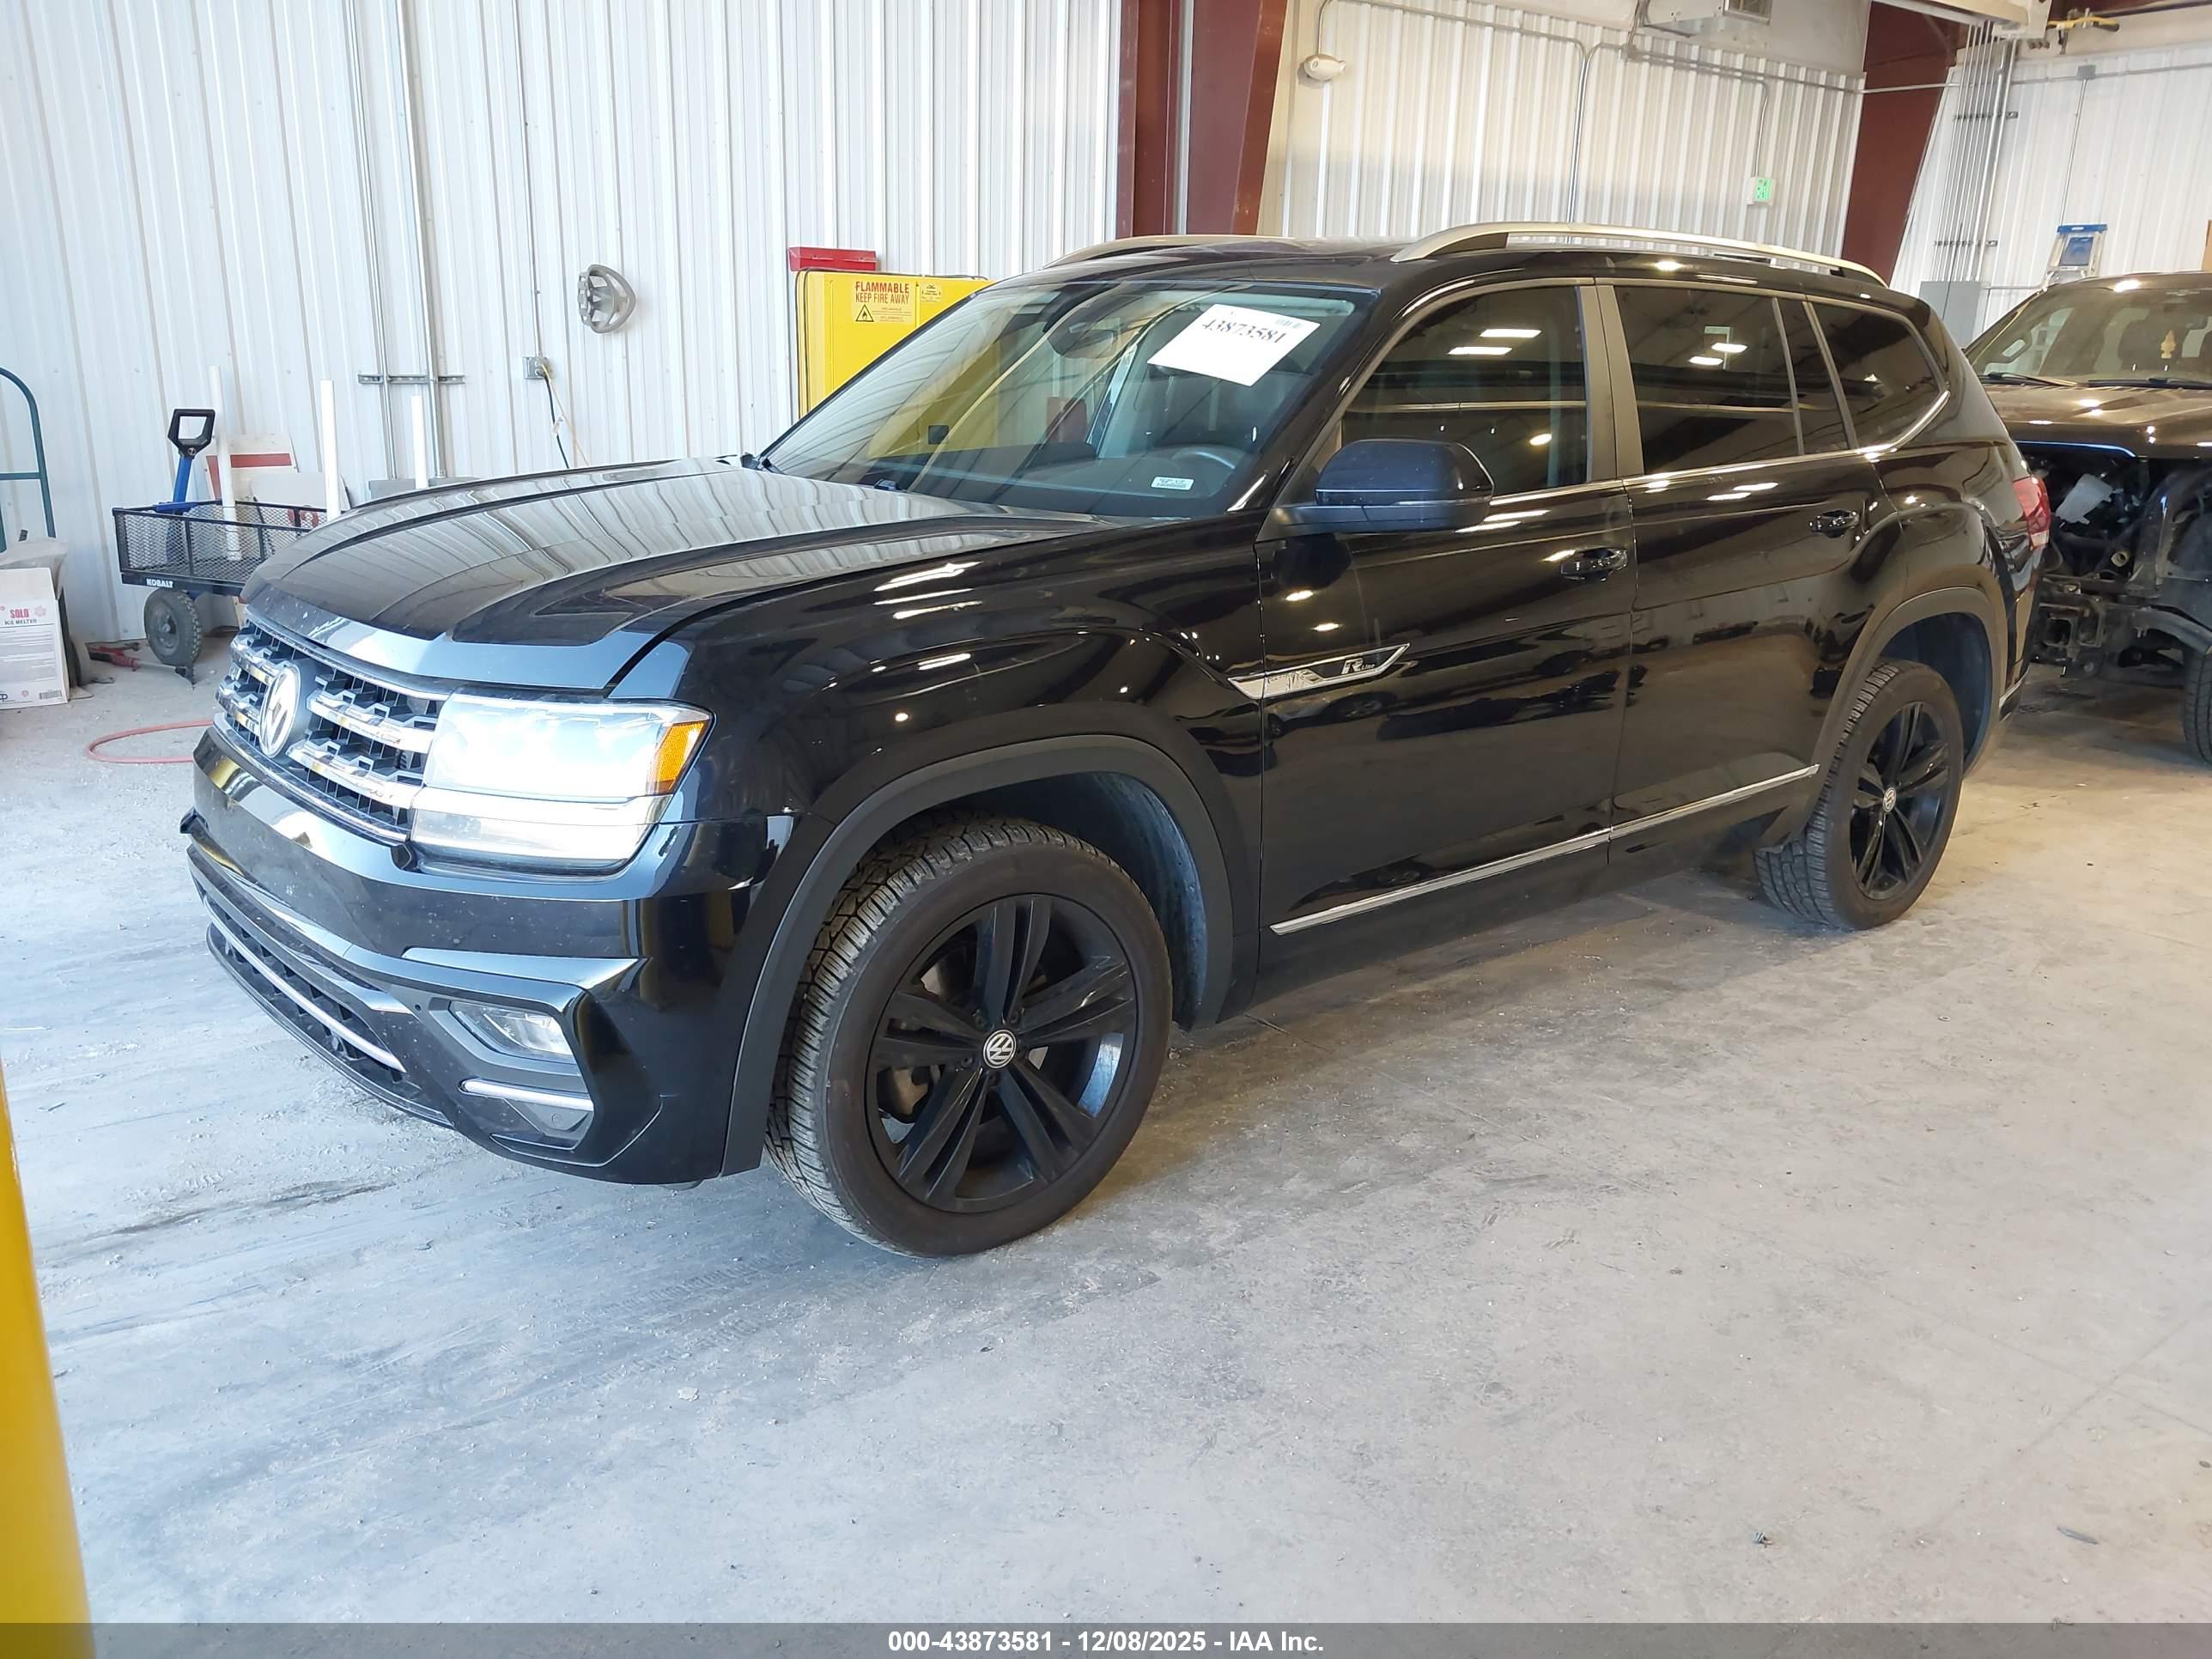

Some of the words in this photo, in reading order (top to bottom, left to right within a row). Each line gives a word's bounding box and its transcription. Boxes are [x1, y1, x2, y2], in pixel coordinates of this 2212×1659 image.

[855, 281, 909, 294] FLAMMABLE
[855, 292, 872, 303] KEEP
[873, 293, 889, 304] FIRE
[890, 294, 910, 305] AWAY
[1202, 319, 1286, 343] 43873581
[146, 578, 173, 588] KOBALT
